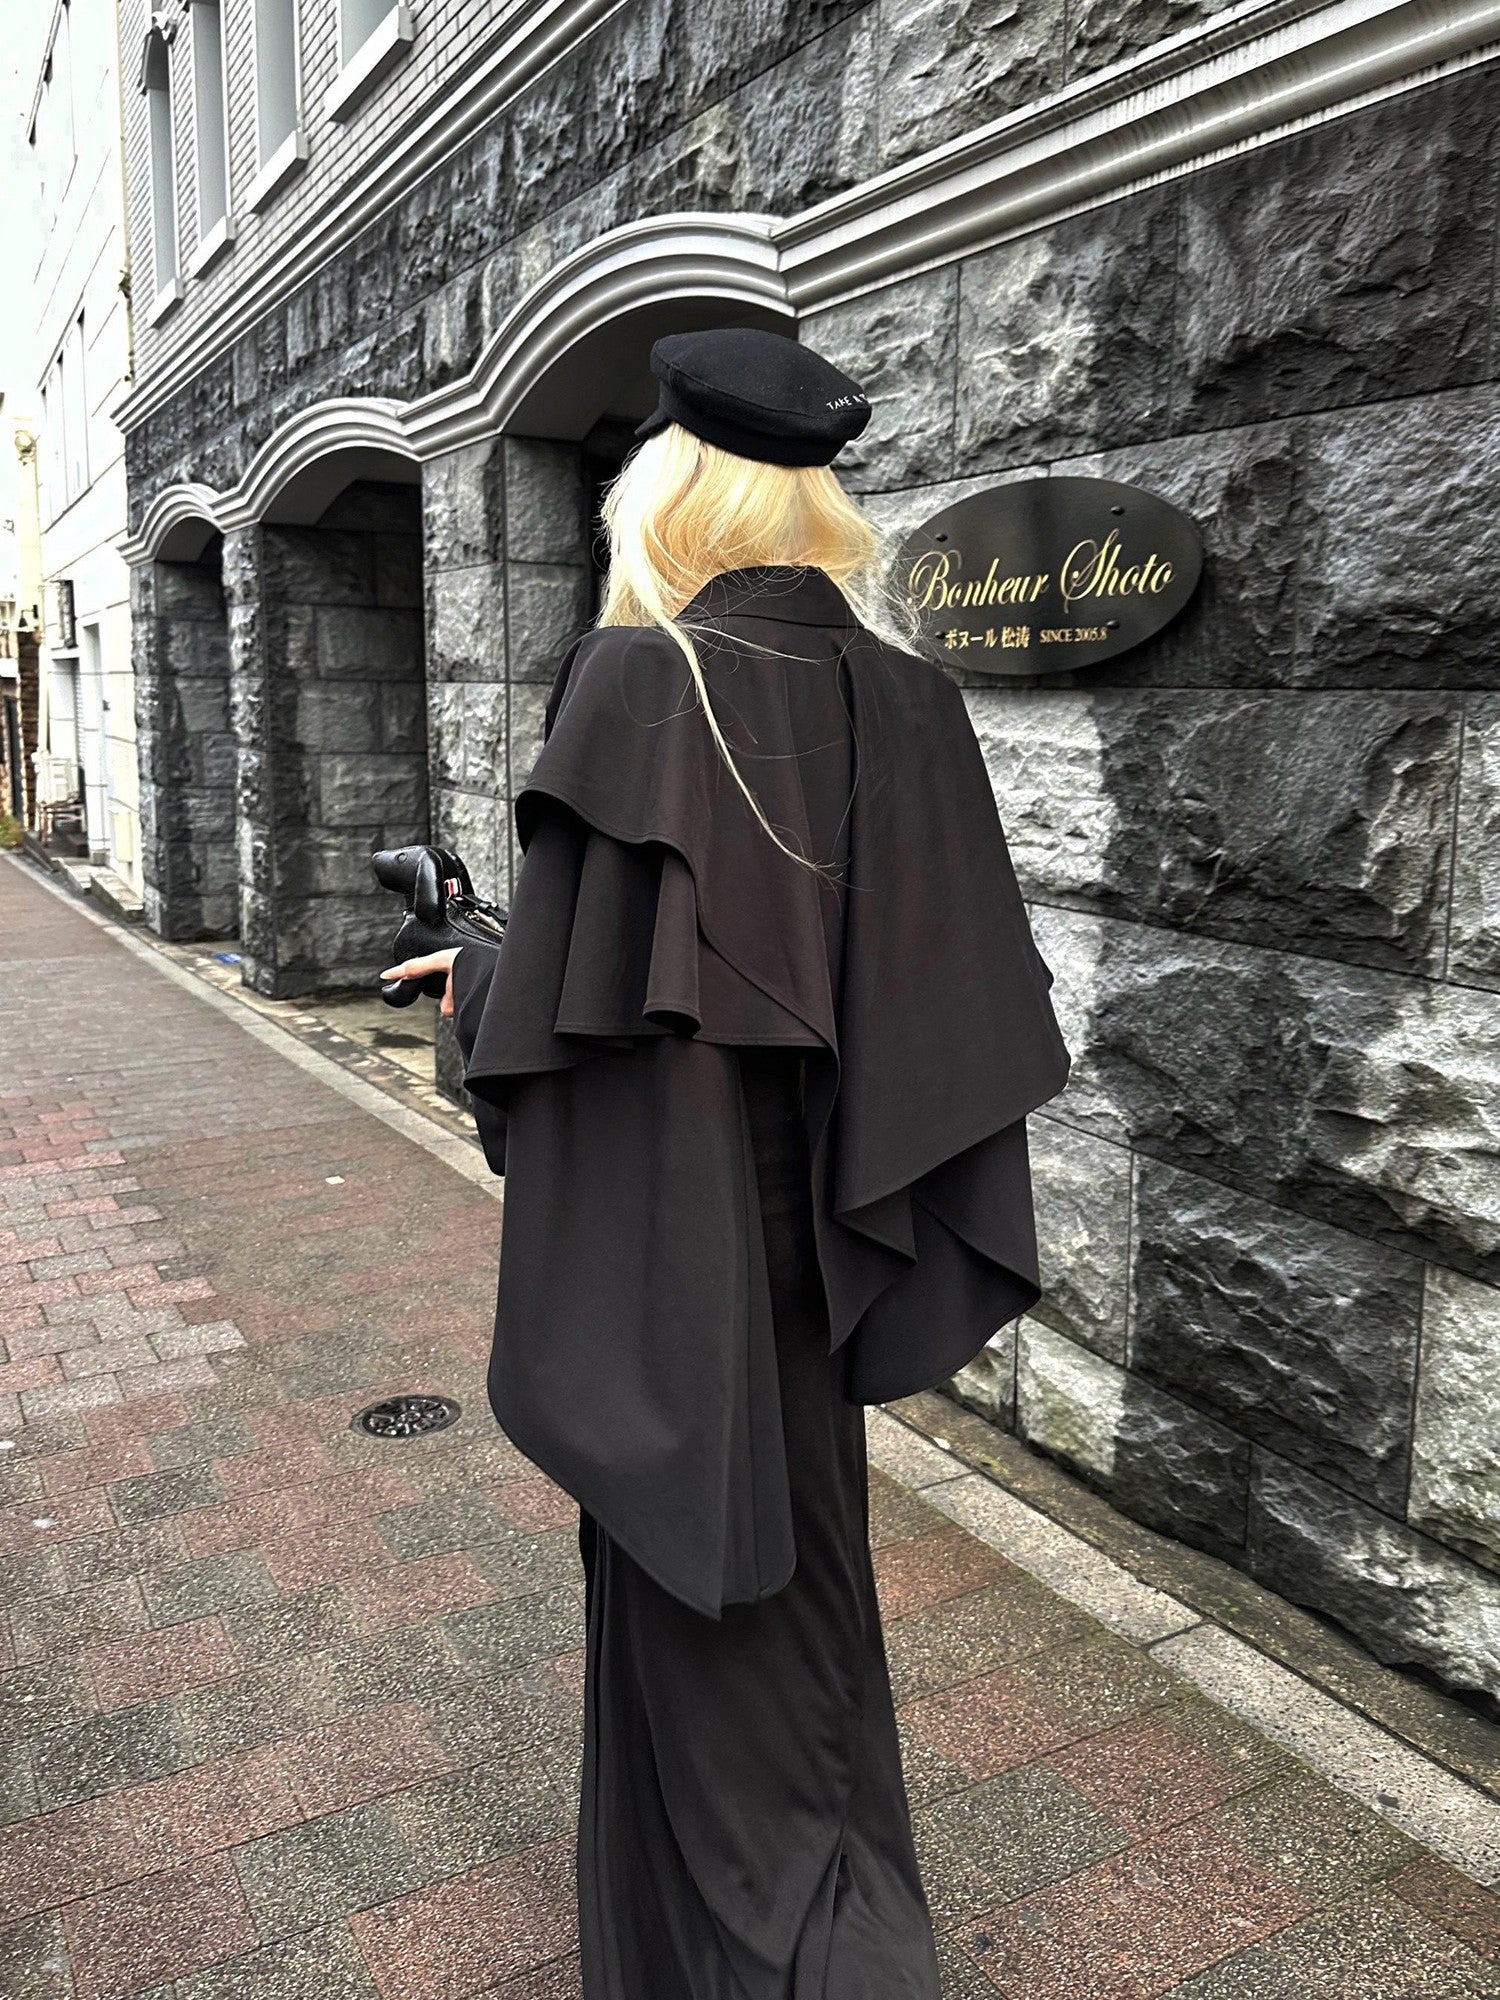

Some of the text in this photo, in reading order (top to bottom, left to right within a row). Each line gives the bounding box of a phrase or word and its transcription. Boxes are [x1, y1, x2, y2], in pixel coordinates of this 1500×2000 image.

[826, 396, 852, 410] TAKE
[908, 528, 1174, 614] Bonheur Shoto
[945, 628, 998, 649] ボヌール
[1039, 629, 1073, 643] SINCE
